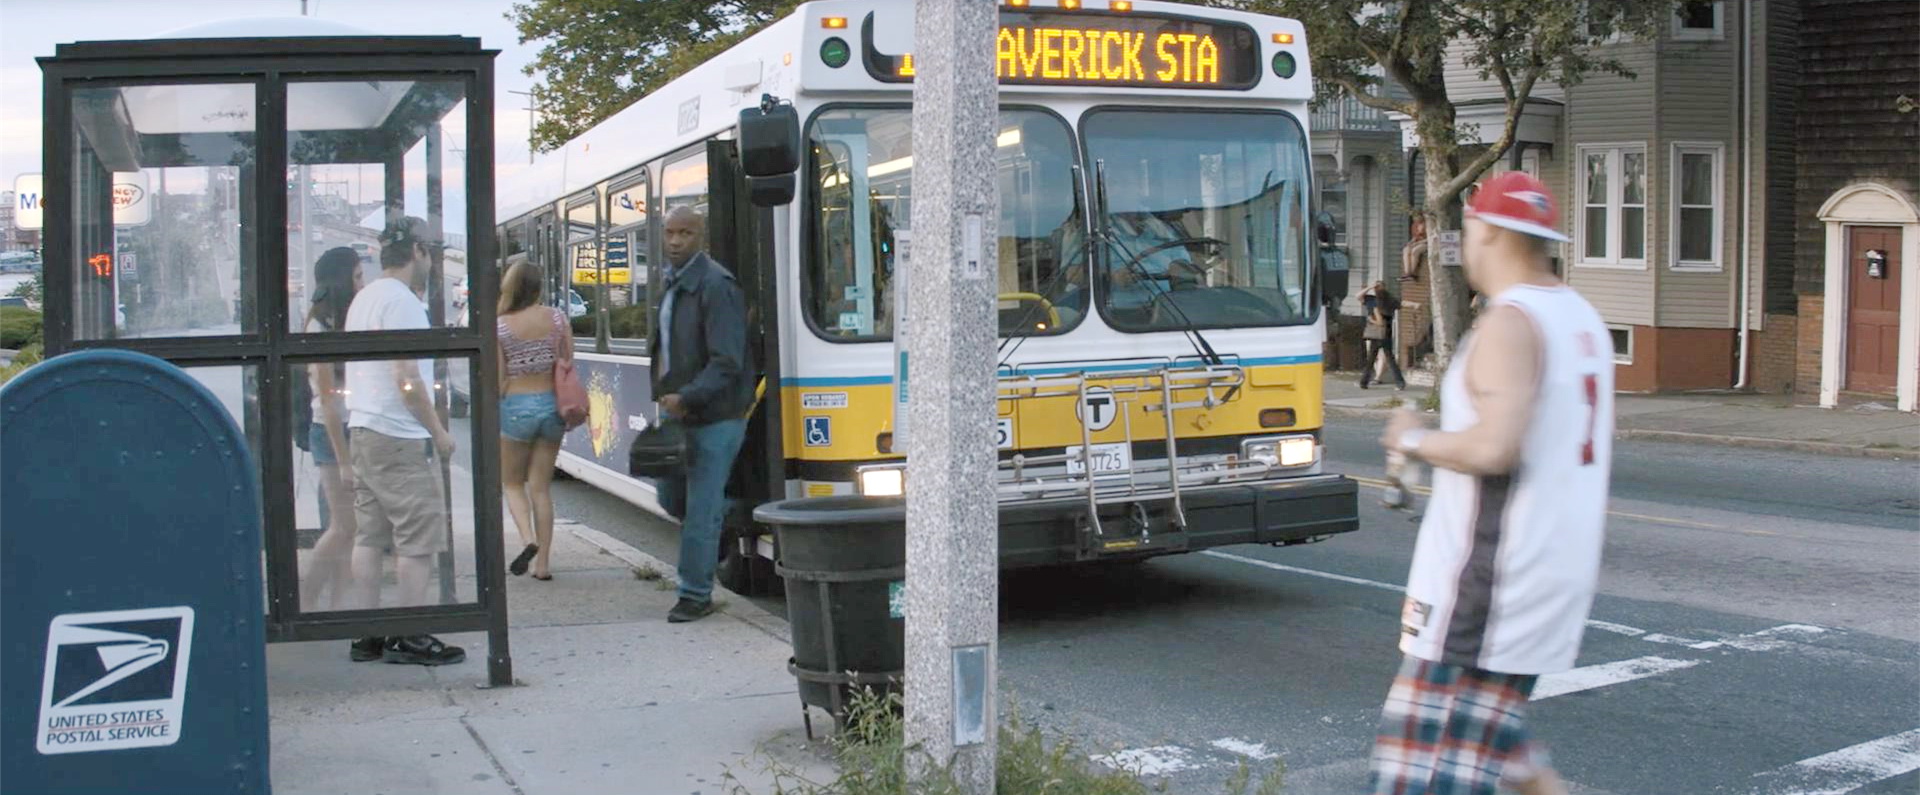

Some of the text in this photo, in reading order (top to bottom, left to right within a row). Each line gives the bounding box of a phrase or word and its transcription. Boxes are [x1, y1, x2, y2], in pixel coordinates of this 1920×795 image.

[996, 27, 1144, 81] AVERICK
[1156, 33, 1218, 83] STA
[112, 188, 137, 196] NCY
[112, 197, 132, 205] EW
[1086, 397, 1110, 423] T
[997, 421, 1007, 445] 5
[48, 709, 164, 729] UNITED STATES
[46, 724, 170, 745] POSTAL SERVICE
